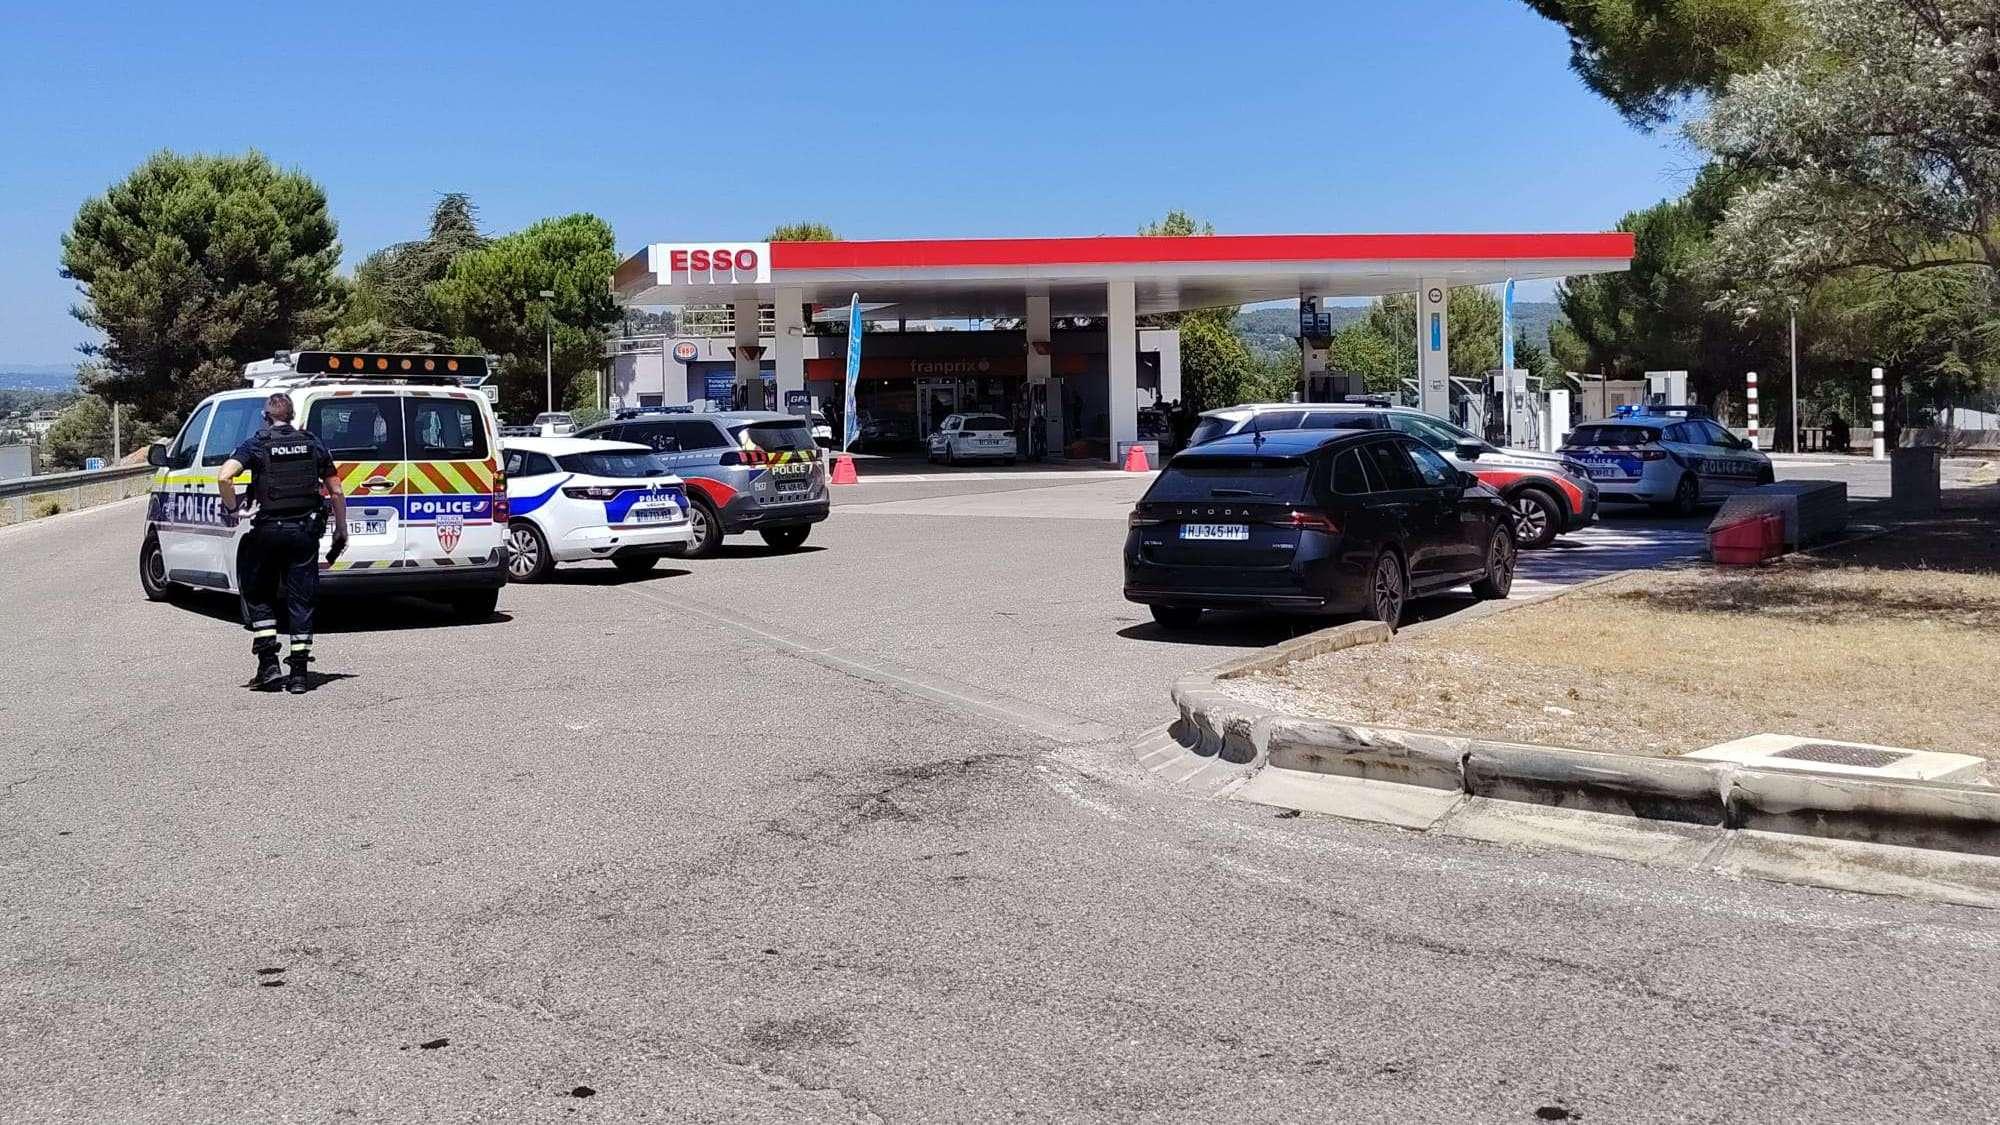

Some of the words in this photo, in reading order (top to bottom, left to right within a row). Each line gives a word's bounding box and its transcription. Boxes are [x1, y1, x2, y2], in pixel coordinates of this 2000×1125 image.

[670, 249, 758, 271] ESSO
[911, 359, 975, 374] franprix
[790, 395, 809, 403] GPL
[271, 445, 307, 456] POLICE
[771, 463, 806, 476] POLICE
[1702, 460, 1737, 474] POLICE
[639, 494, 670, 503] POLICE
[178, 495, 222, 523] POLICE
[410, 501, 471, 514] POLICE
[437, 525, 461, 537] CRS
